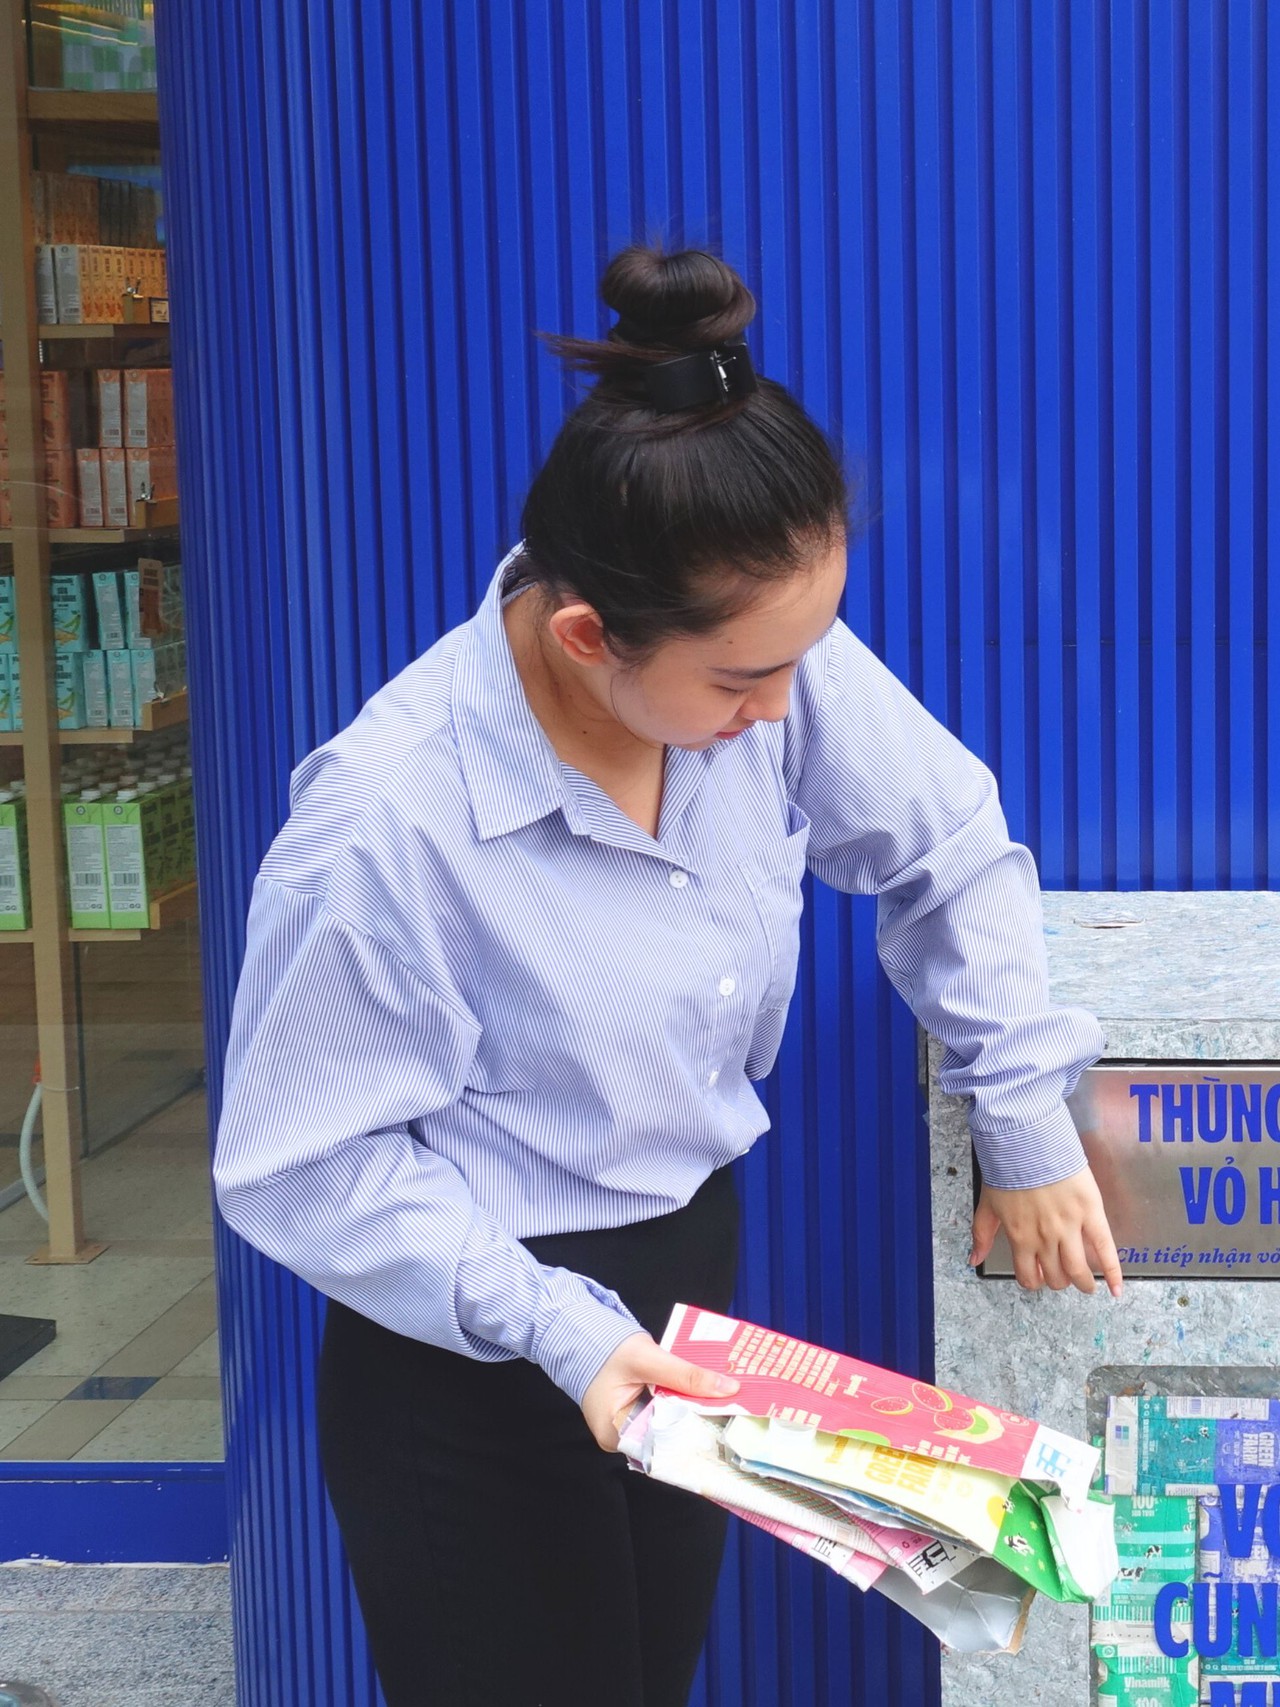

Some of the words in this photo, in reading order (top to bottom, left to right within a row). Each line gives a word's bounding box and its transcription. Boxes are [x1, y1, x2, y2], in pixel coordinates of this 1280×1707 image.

[1180, 1156, 1246, 1225] VỎ
[1117, 1248, 1148, 1264] Chỉ
[1154, 1245, 1194, 1267] tiếp
[1199, 1248, 1252, 1269] nhận
[1242, 1432, 1259, 1466] FARM
[1259, 1431, 1275, 1467] GREEN
[1123, 1676, 1170, 1690] Vinamilk
